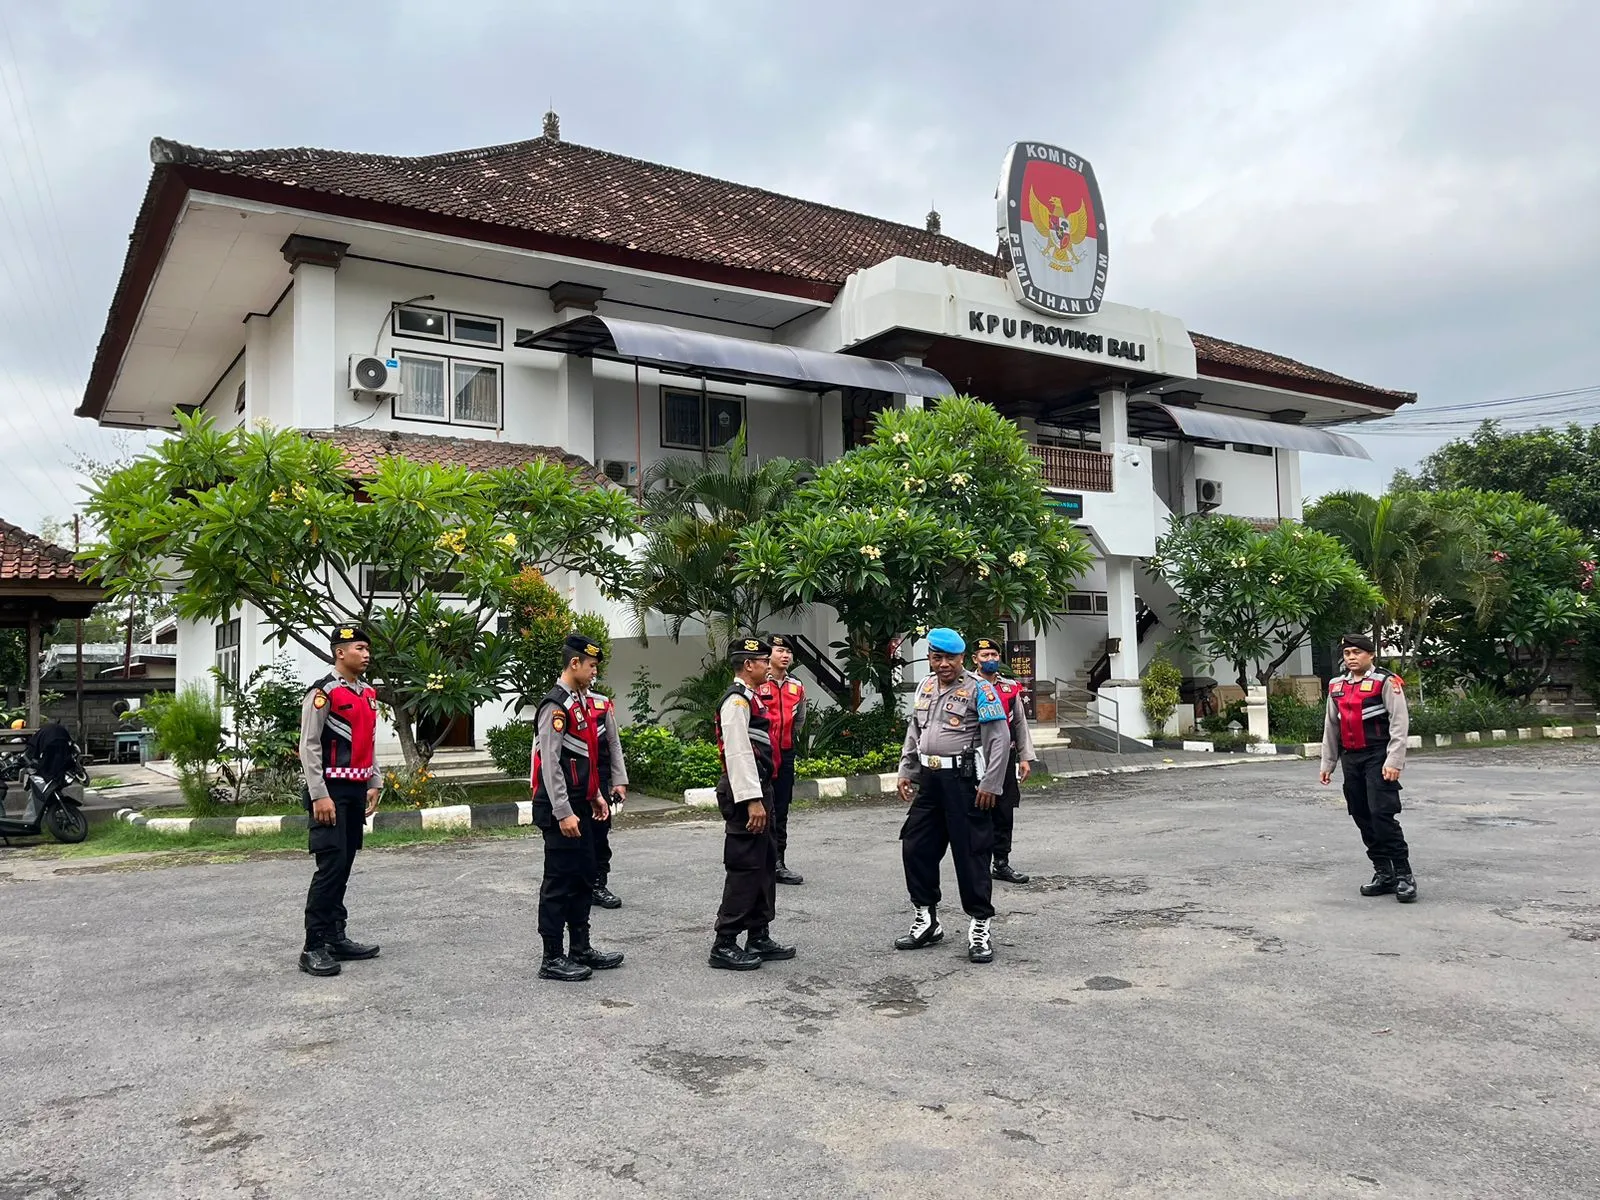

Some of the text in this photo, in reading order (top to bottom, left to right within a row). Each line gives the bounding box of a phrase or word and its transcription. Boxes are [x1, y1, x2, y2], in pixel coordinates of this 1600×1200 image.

[1026, 144, 1084, 173] KOMISI
[1010, 232, 1108, 312] PEMILIHAN UMUM
[969, 310, 1145, 362] KPU PROVINSI BALI
[948, 695, 969, 704] POLRI
